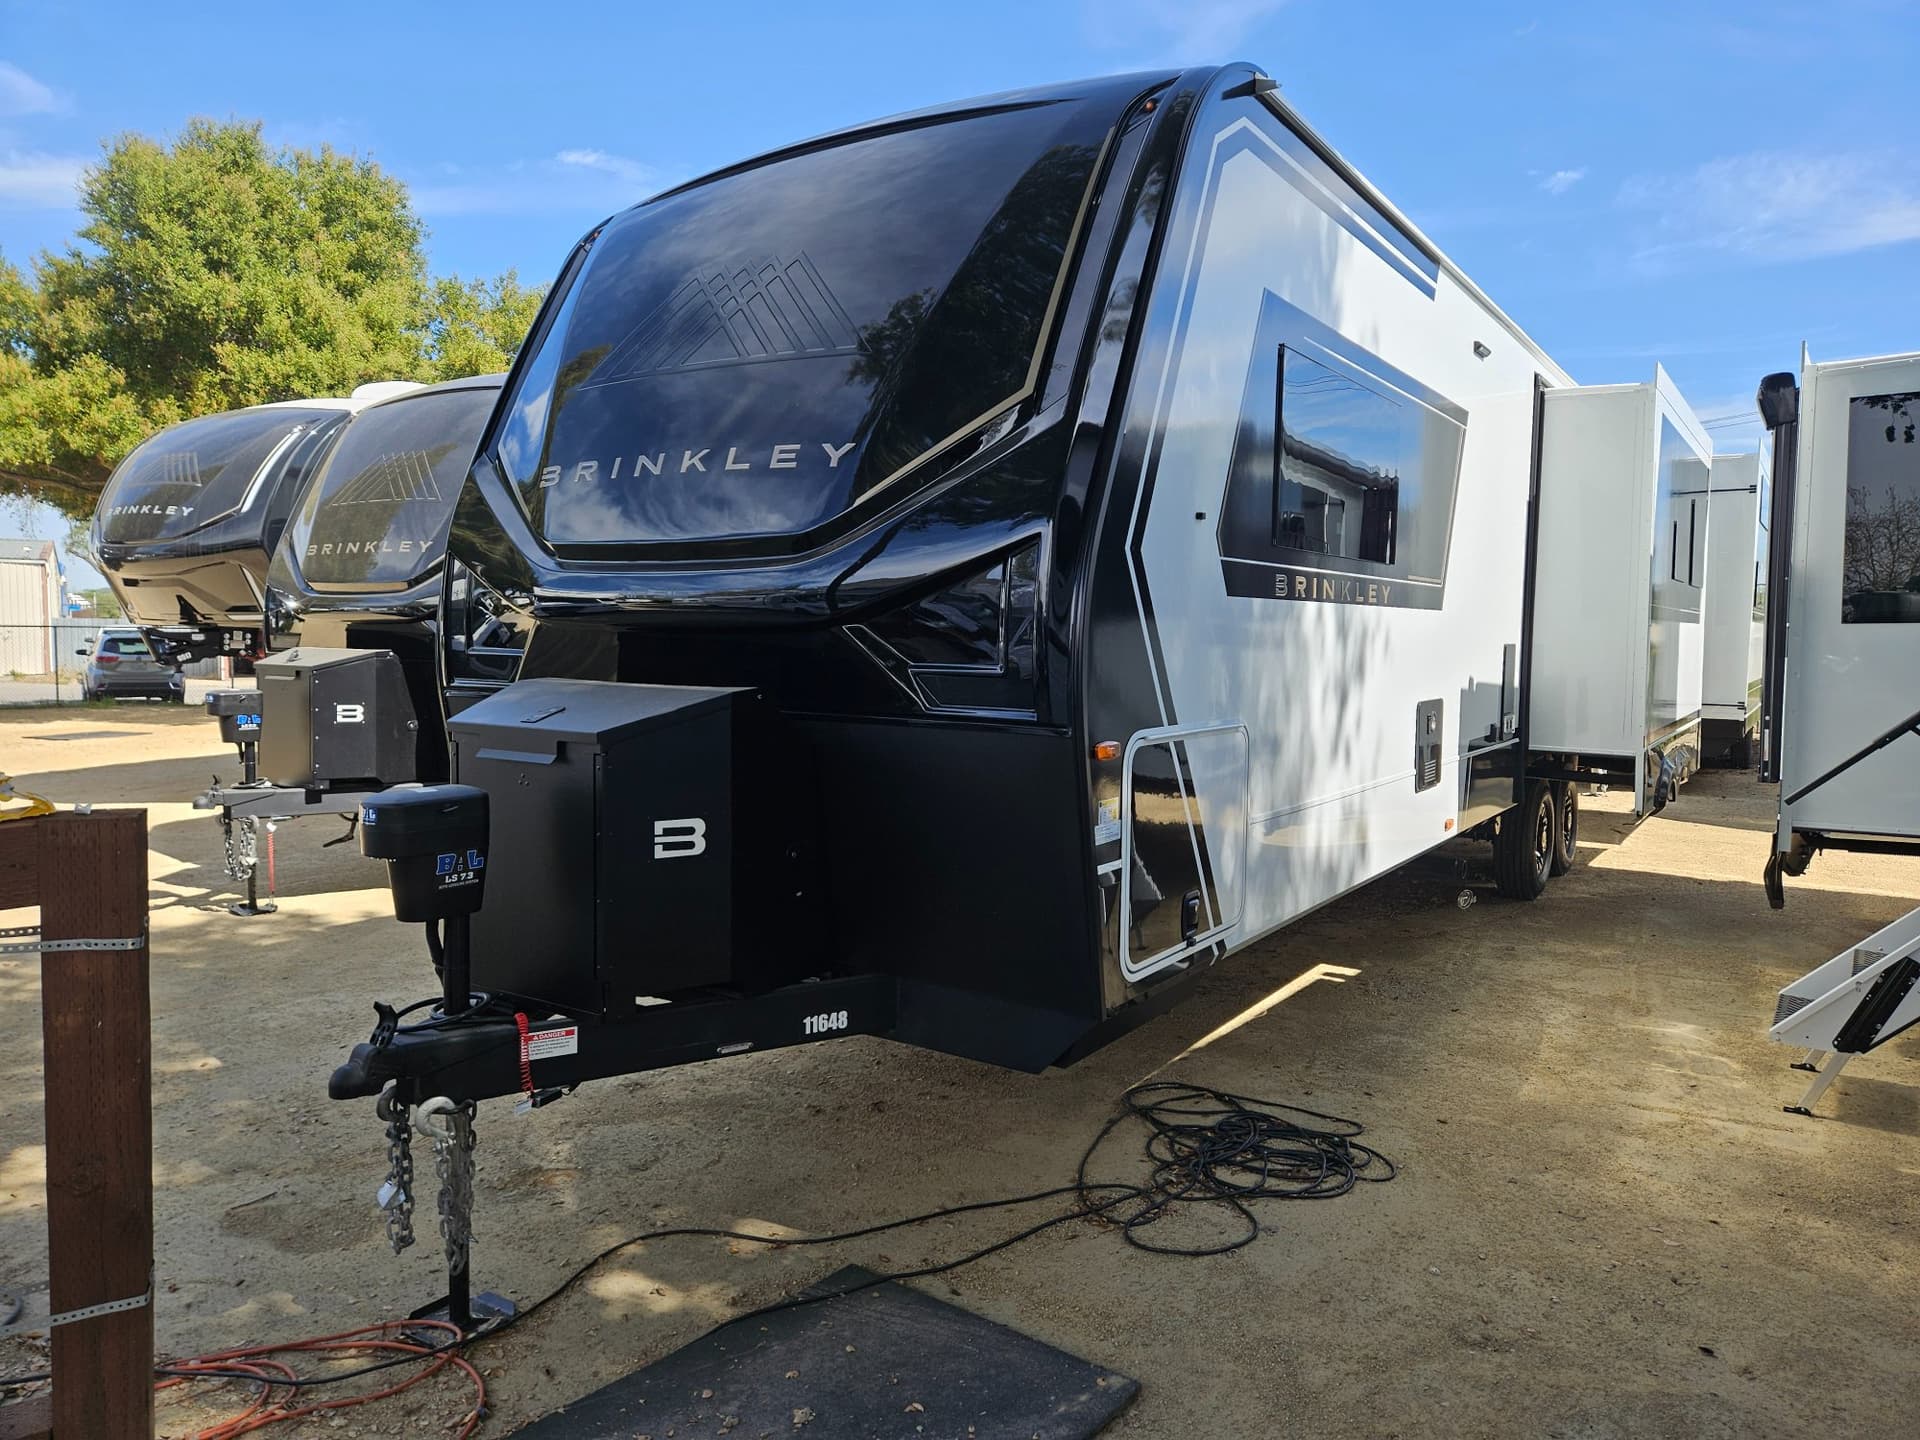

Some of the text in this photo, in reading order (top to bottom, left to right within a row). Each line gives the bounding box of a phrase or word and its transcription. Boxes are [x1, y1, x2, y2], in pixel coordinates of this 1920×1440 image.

[539, 442, 856, 489] BRINKLEY
[307, 540, 434, 556] BRINKLEY
[1275, 573, 1391, 604] BRINKLEY
[445, 874, 459, 884] LS
[803, 1010, 848, 1035] 11648
[538, 1030, 566, 1041] DANGER
